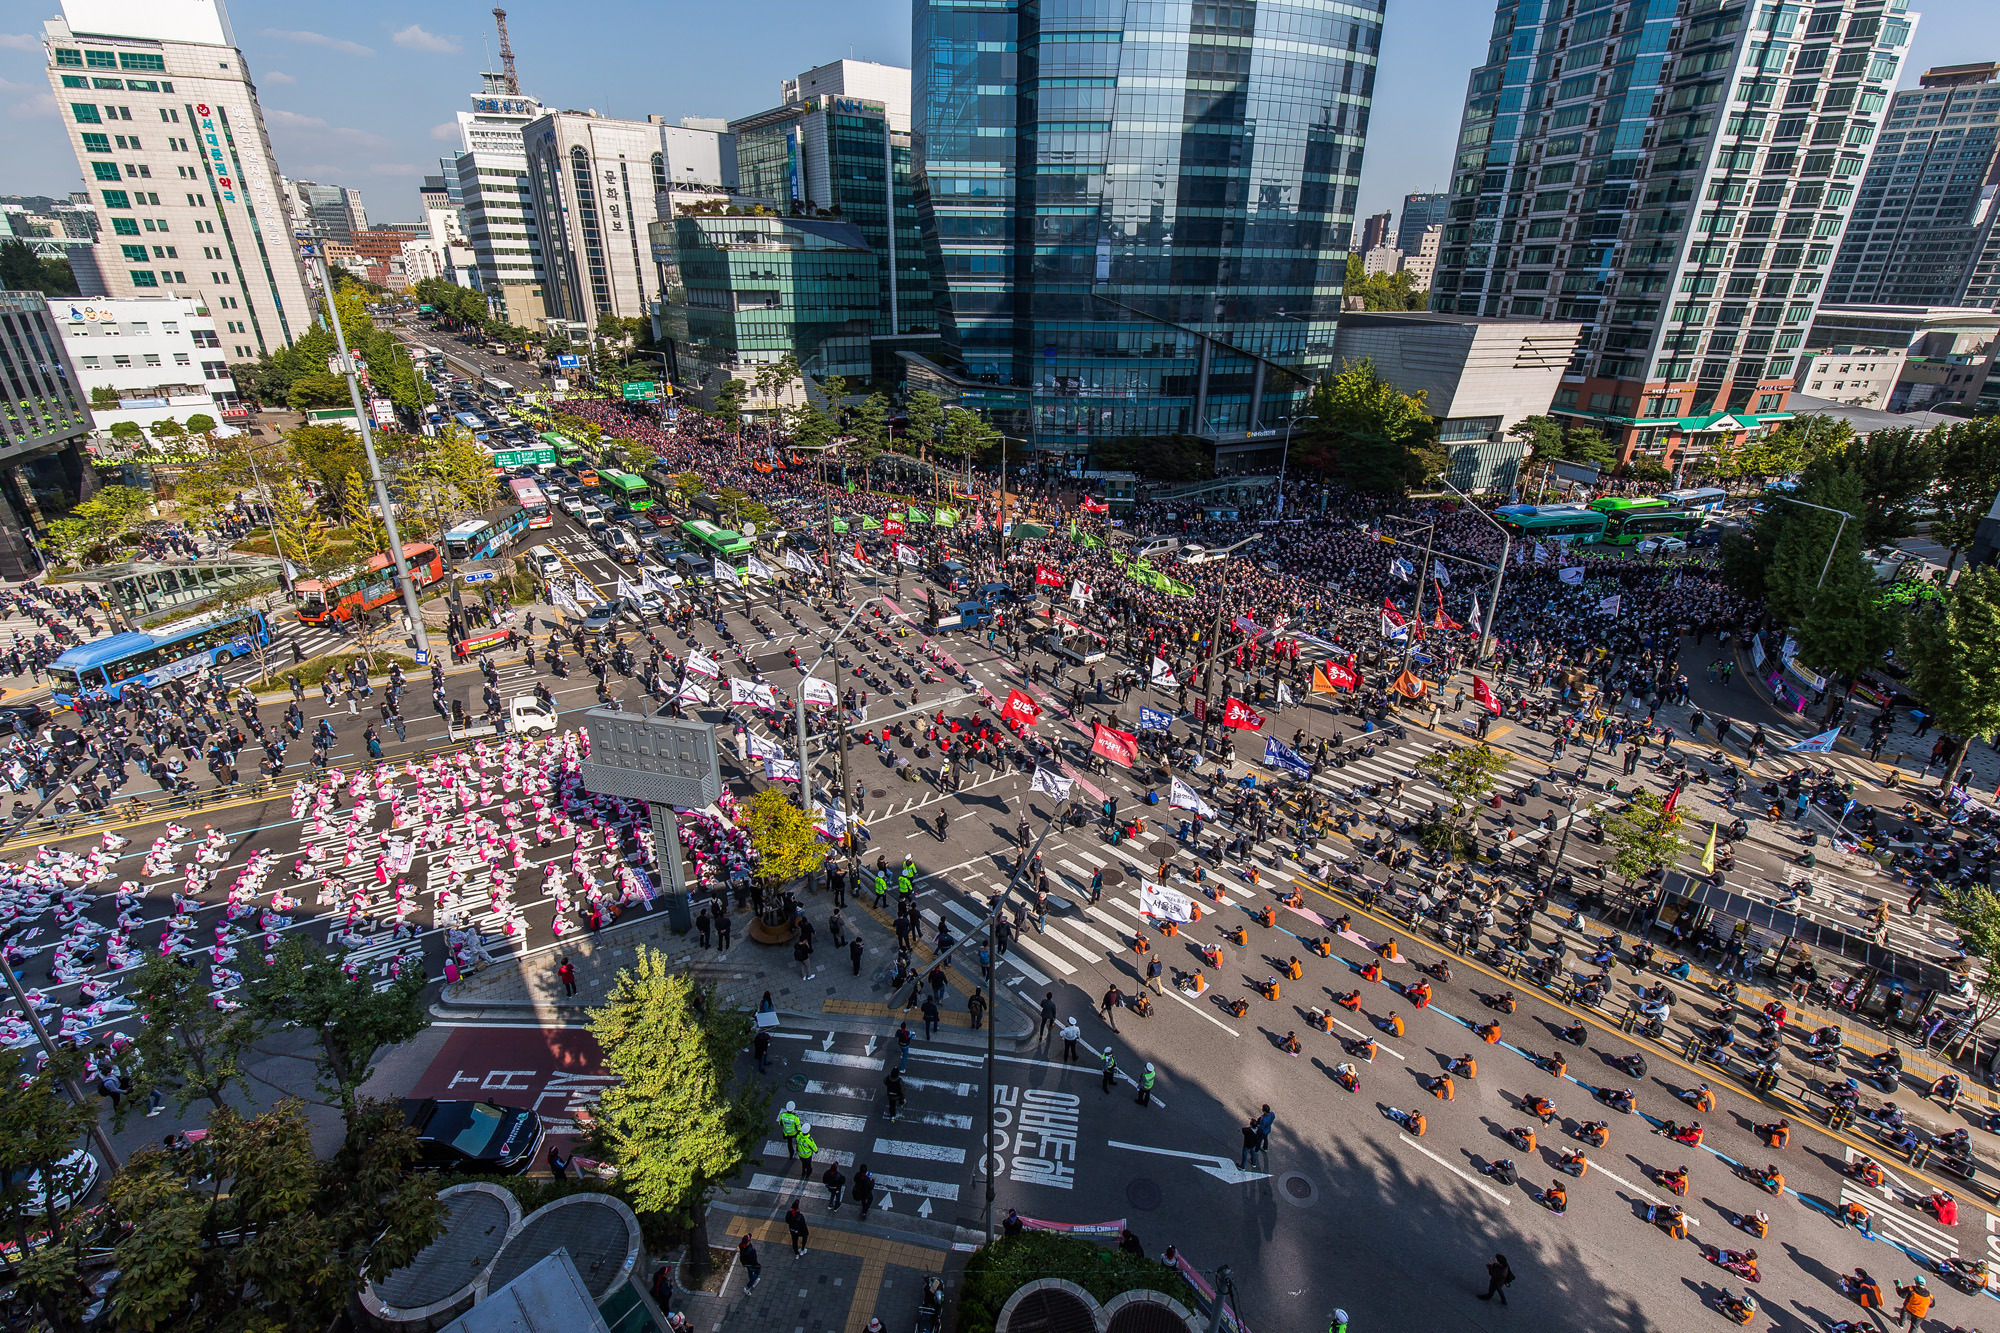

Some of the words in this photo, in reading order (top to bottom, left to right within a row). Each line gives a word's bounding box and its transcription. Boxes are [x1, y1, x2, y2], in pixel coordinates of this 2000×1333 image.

[478, 99, 525, 112] 경향신문
[837, 98, 862, 113] NH
[604, 170, 624, 232] 문화일보
